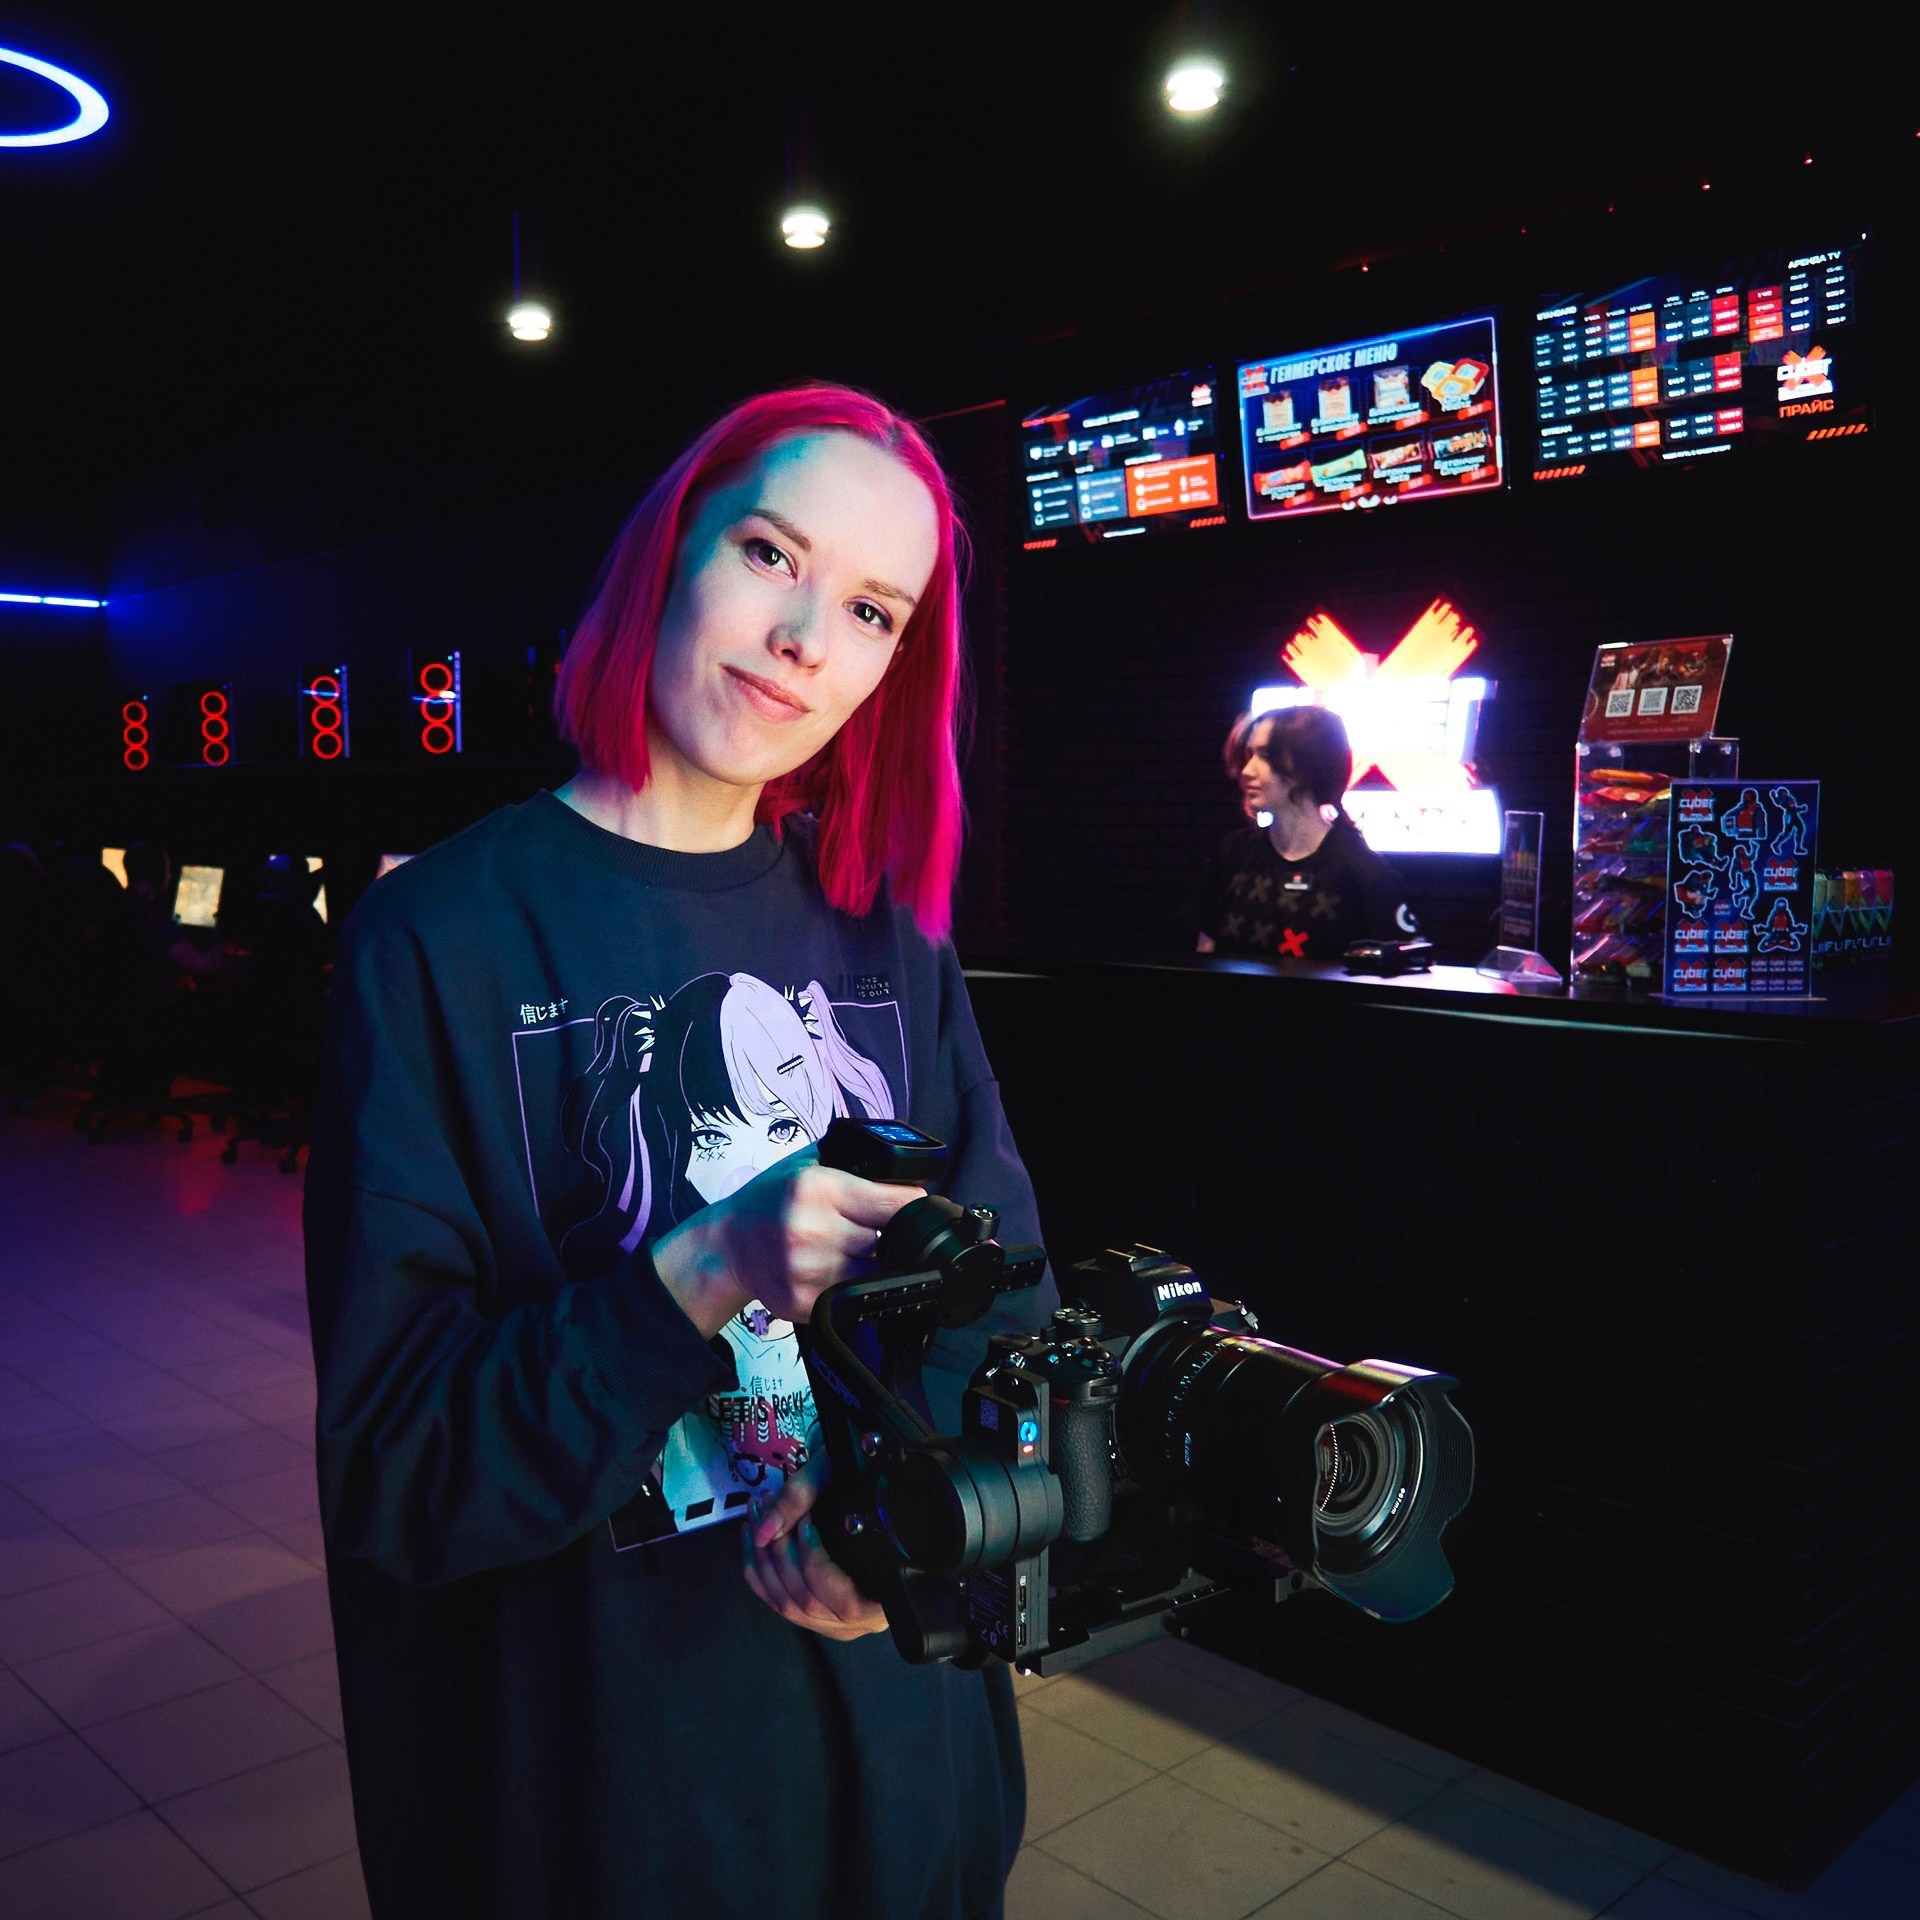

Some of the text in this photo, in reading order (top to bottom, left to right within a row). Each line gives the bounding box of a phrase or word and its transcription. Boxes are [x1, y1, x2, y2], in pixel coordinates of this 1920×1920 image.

[1788, 250, 1842, 269] АРЕНДА TV
[1354, 342, 1399, 368] МЕНЮ
[1779, 399, 1835, 418] ПРАЙС
[1679, 796, 1716, 810] cyber
[1763, 866, 1798, 881] cyber
[1675, 928, 1709, 942] cyber
[1714, 928, 1749, 942] cyber
[1673, 966, 1708, 980] cyber
[1713, 966, 1748, 980] cyber
[520, 998, 569, 1025] 信じます
[1157, 1280, 1202, 1301] Nikon
[750, 1375, 784, 1396] 信じます
